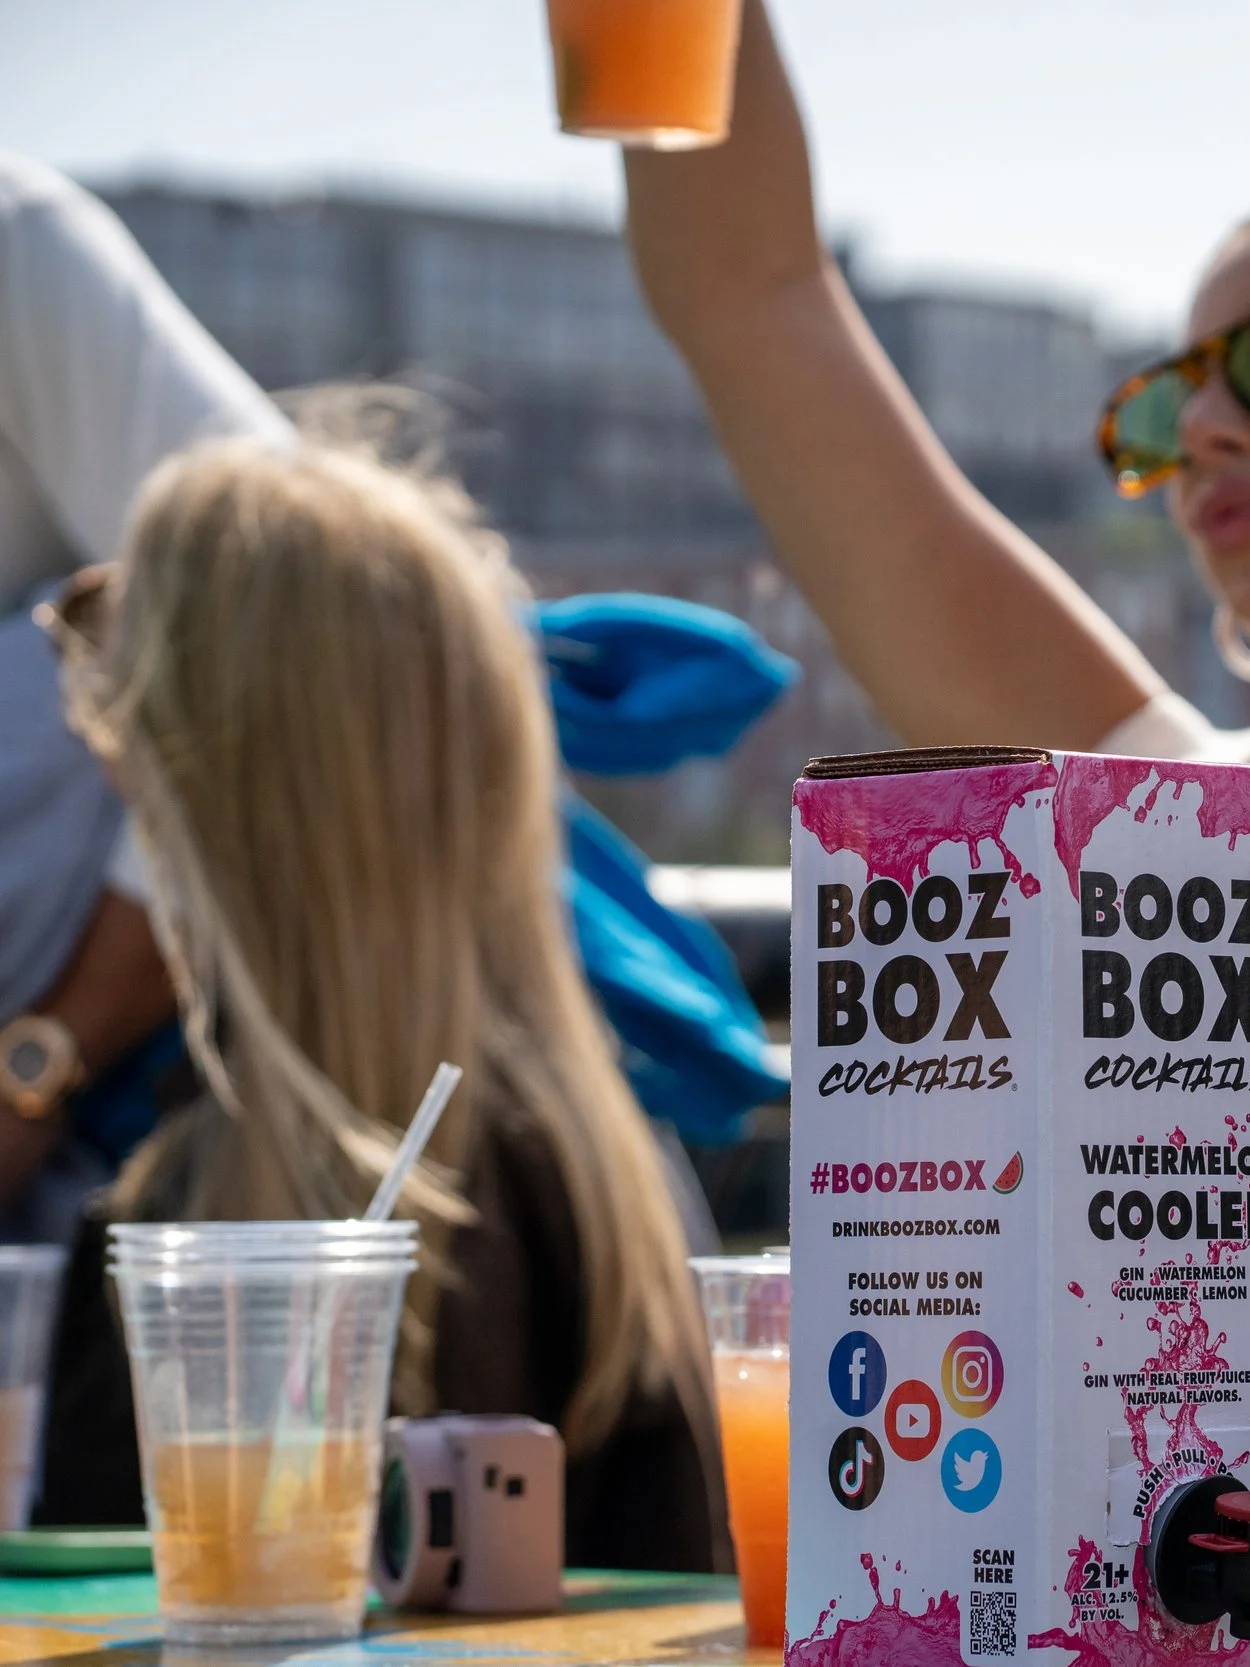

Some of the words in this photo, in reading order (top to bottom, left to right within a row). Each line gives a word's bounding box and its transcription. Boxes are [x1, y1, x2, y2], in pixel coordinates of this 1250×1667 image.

[818, 872, 1011, 949] BOOZ
[818, 951, 1012, 1047] BOX
[818, 1055, 1013, 1096] COCKTAILS
[810, 1160, 987, 1194] #BOOZBOX
[832, 1219, 1000, 1237] DRINKBOOZBOX.COM
[849, 1272, 919, 1290] FOLLOW
[926, 1272, 948, 1290] US
[955, 1271, 983, 1289] ON
[1119, 1267, 1144, 1281] GIN
[1158, 1266, 1246, 1280] WATERMELON
[1118, 1286, 1188, 1301] CUCUMBER
[1202, 1286, 1247, 1299] LEMON
[849, 1299, 910, 1316] SOCIAL
[916, 1298, 981, 1316] MEDIA:
[1084, 1374, 1108, 1388] GIN
[1113, 1373, 1145, 1387] WITH
[1150, 1372, 1180, 1385] REAL
[1183, 1371, 1216, 1385] FRUIT
[1219, 1371, 1250, 1384] JUICE
[1127, 1391, 1182, 1405] NATURAL
[1186, 1390, 1242, 1404] FLAVORS.
[1133, 1467, 1164, 1519] PUSH
[1172, 1449, 1207, 1468] PULL
[973, 1549, 1015, 1565] SCAN
[974, 1568, 1013, 1584] HERE
[1082, 1562, 1129, 1590] 21+
[1071, 1593, 1095, 1606] ALC.
[1101, 1591, 1138, 1604] 12.5%
[1081, 1610, 1096, 1621] BY
[1100, 1609, 1124, 1620] VOL.
